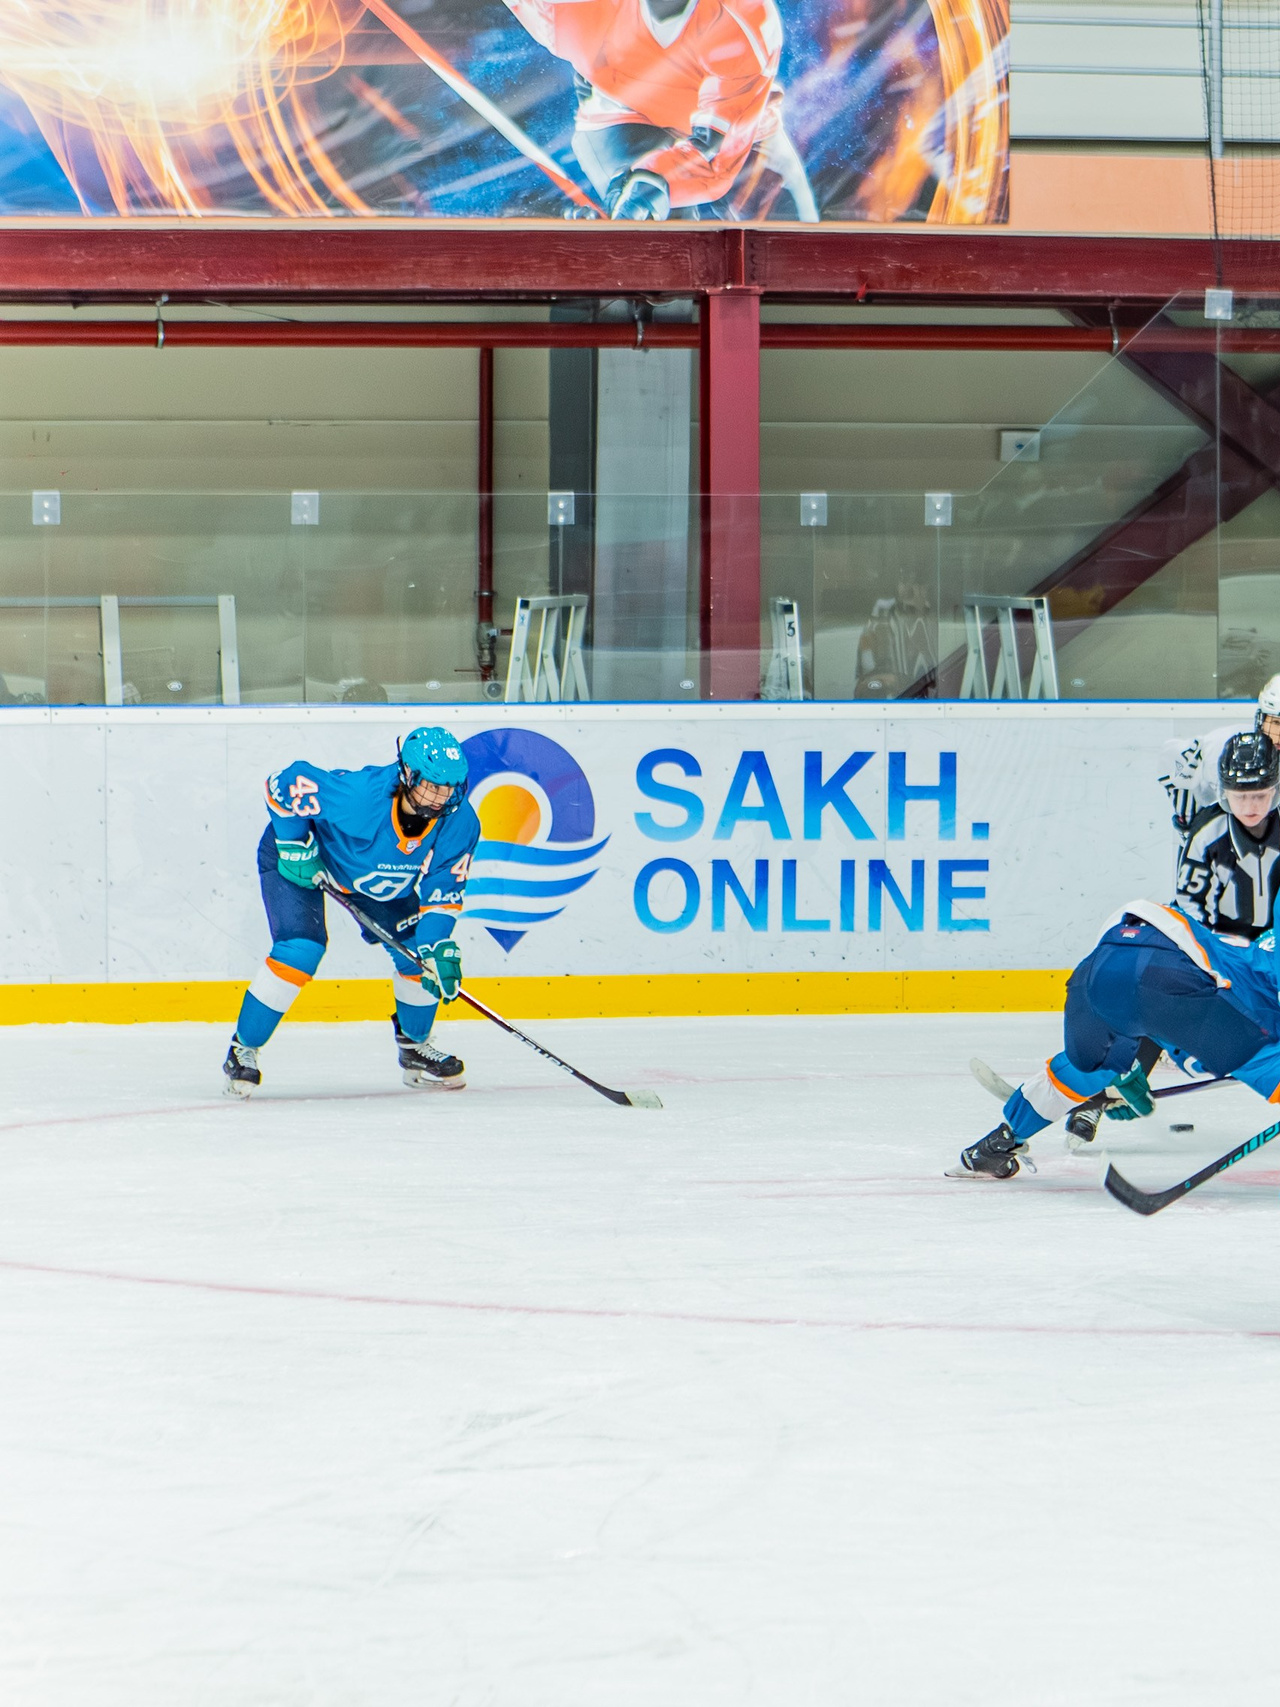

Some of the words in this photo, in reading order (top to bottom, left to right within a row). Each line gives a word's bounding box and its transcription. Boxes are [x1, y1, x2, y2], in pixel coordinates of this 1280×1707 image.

[786, 621, 796, 637] 5
[289, 775, 321, 817] 43
[633, 747, 991, 843] SAKH.
[450, 852, 474, 882] 4
[633, 857, 991, 934] ONLINE
